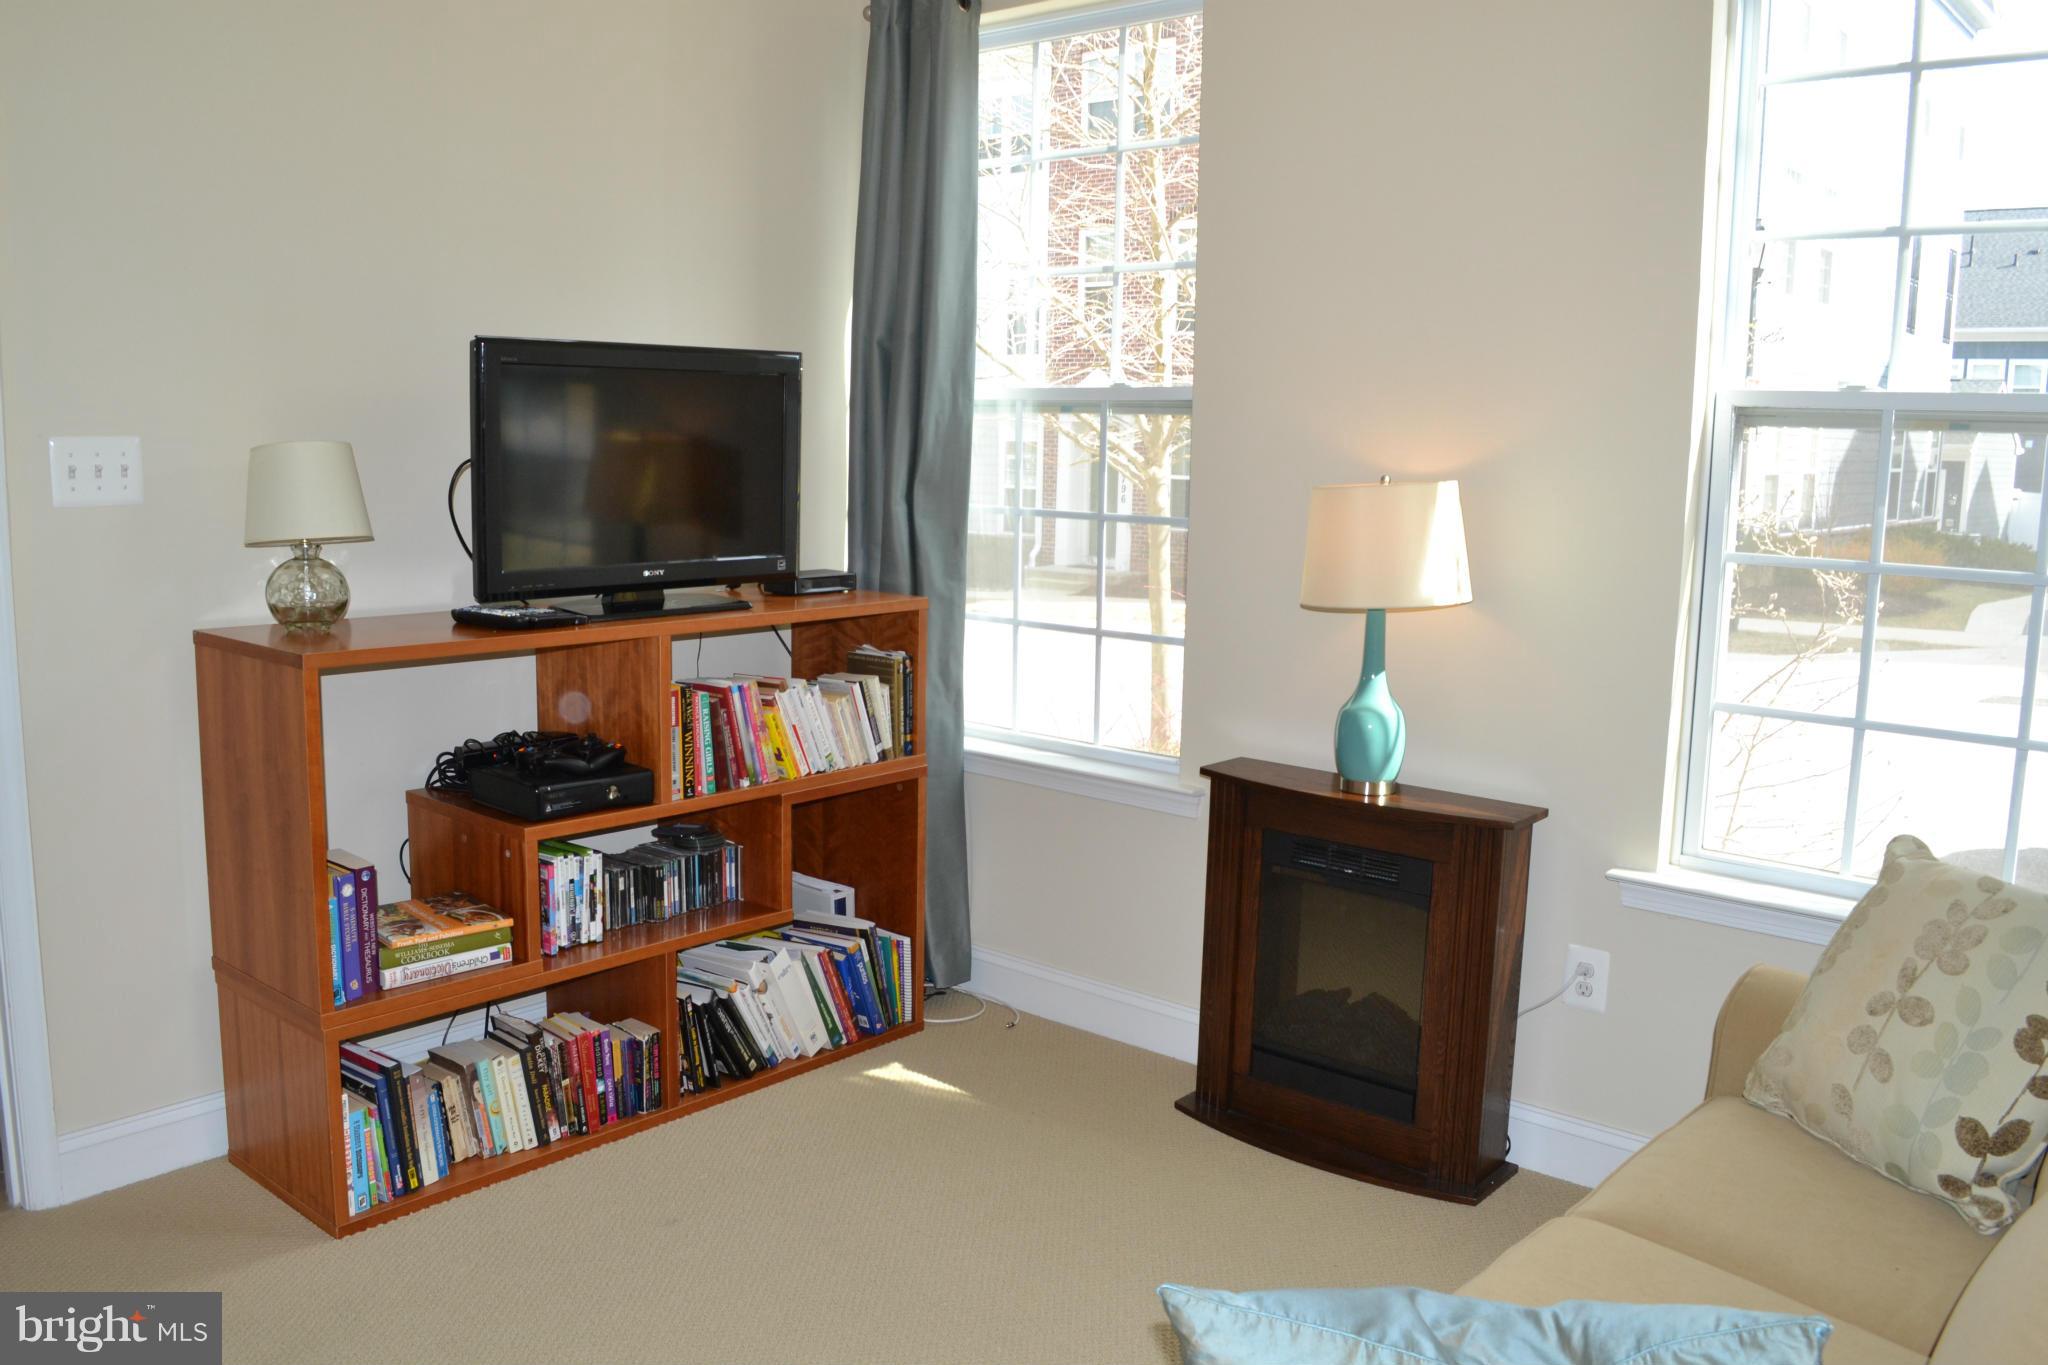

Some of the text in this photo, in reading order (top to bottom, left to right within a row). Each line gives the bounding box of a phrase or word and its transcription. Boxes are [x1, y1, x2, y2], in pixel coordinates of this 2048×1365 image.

[643, 569, 664, 577] SONY
[703, 707, 713, 774] RAISING GIRLS
[684, 731, 694, 787] WINNING
[361, 887, 369, 931] DICTIONARY
[344, 923, 352, 952] STORIES
[364, 941, 373, 984] THESAURUS
[400, 950, 450, 965] COOKBOOK
[401, 955, 489, 982] Children's Dictionary
[857, 962, 868, 984] puntos
[535, 1045, 545, 1073] DICKEY
[543, 1084, 551, 1112] PARADISE
